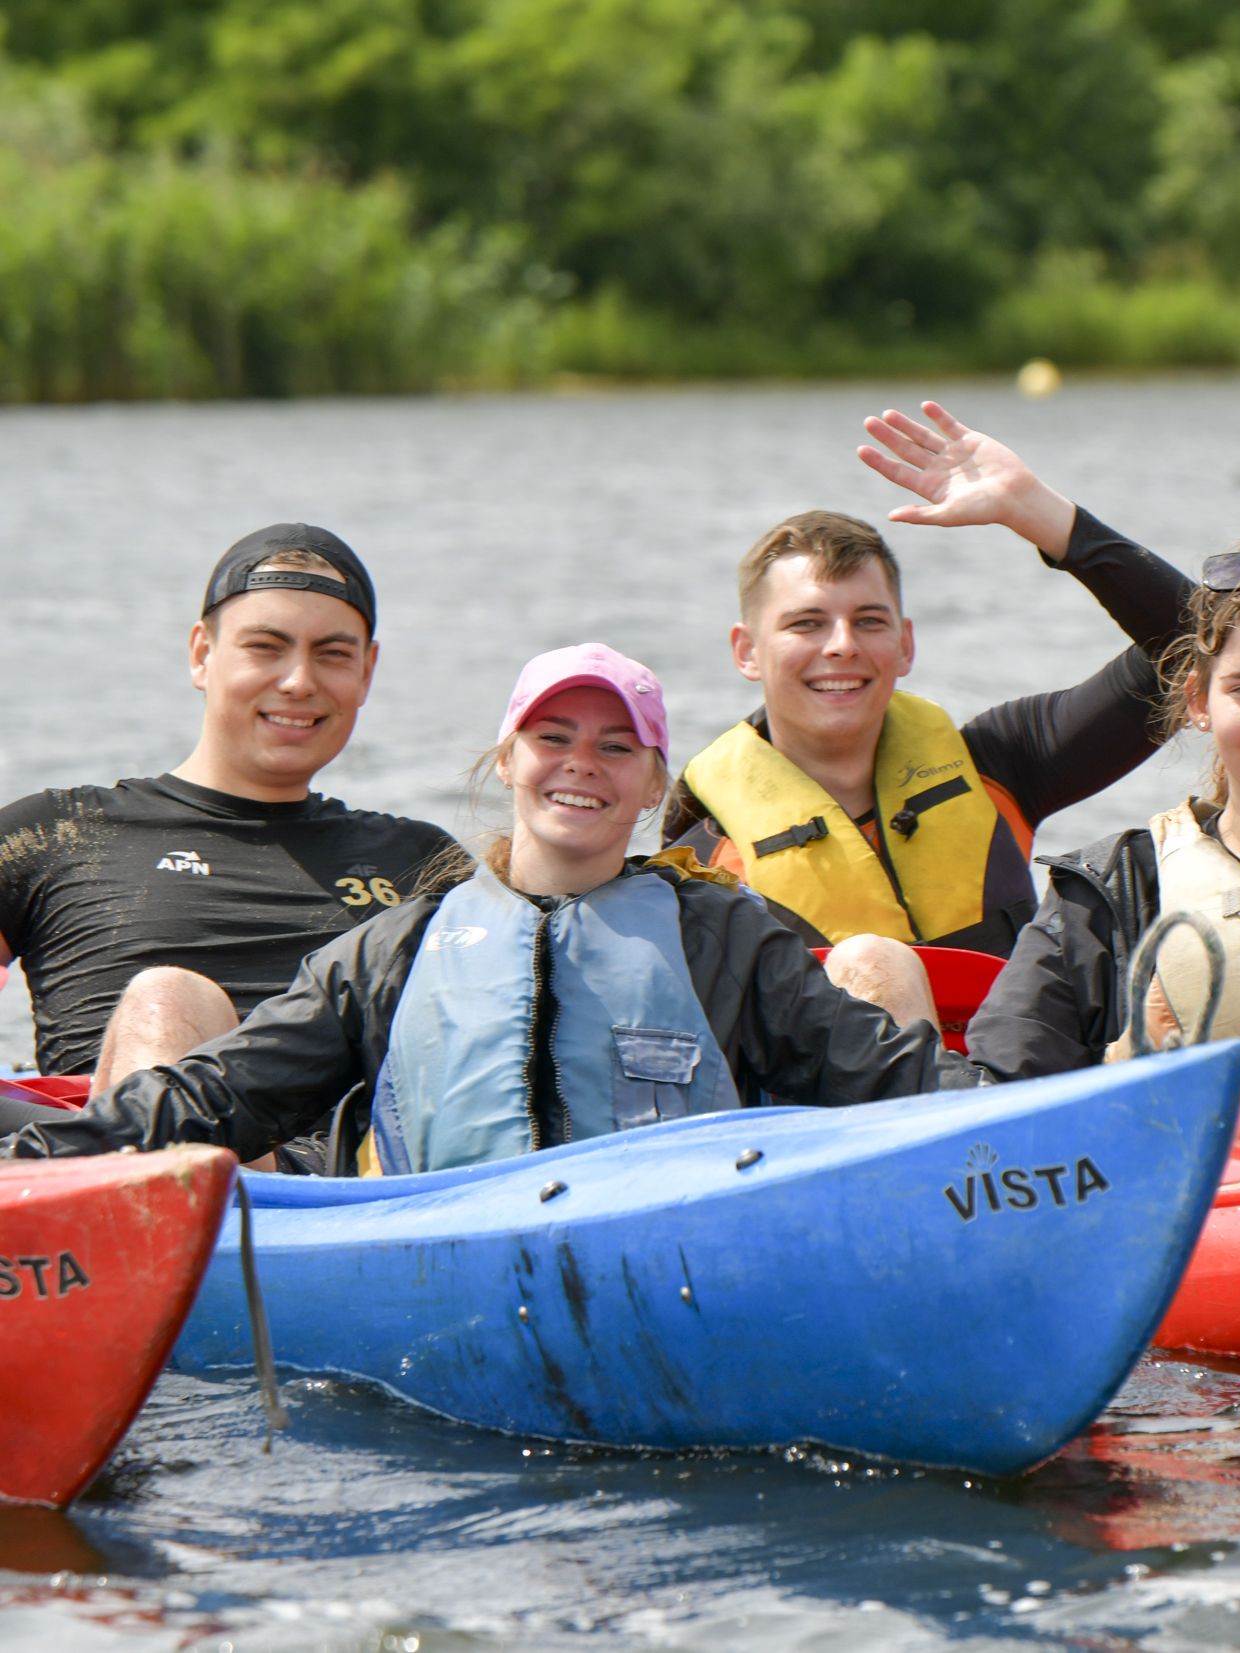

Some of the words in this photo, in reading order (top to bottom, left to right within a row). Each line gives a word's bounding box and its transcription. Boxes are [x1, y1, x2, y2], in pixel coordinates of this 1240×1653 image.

[916, 759, 964, 779] Olimp
[156, 857, 213, 876] APN
[333, 877, 402, 907] 36
[944, 1155, 1111, 1222] VISTA
